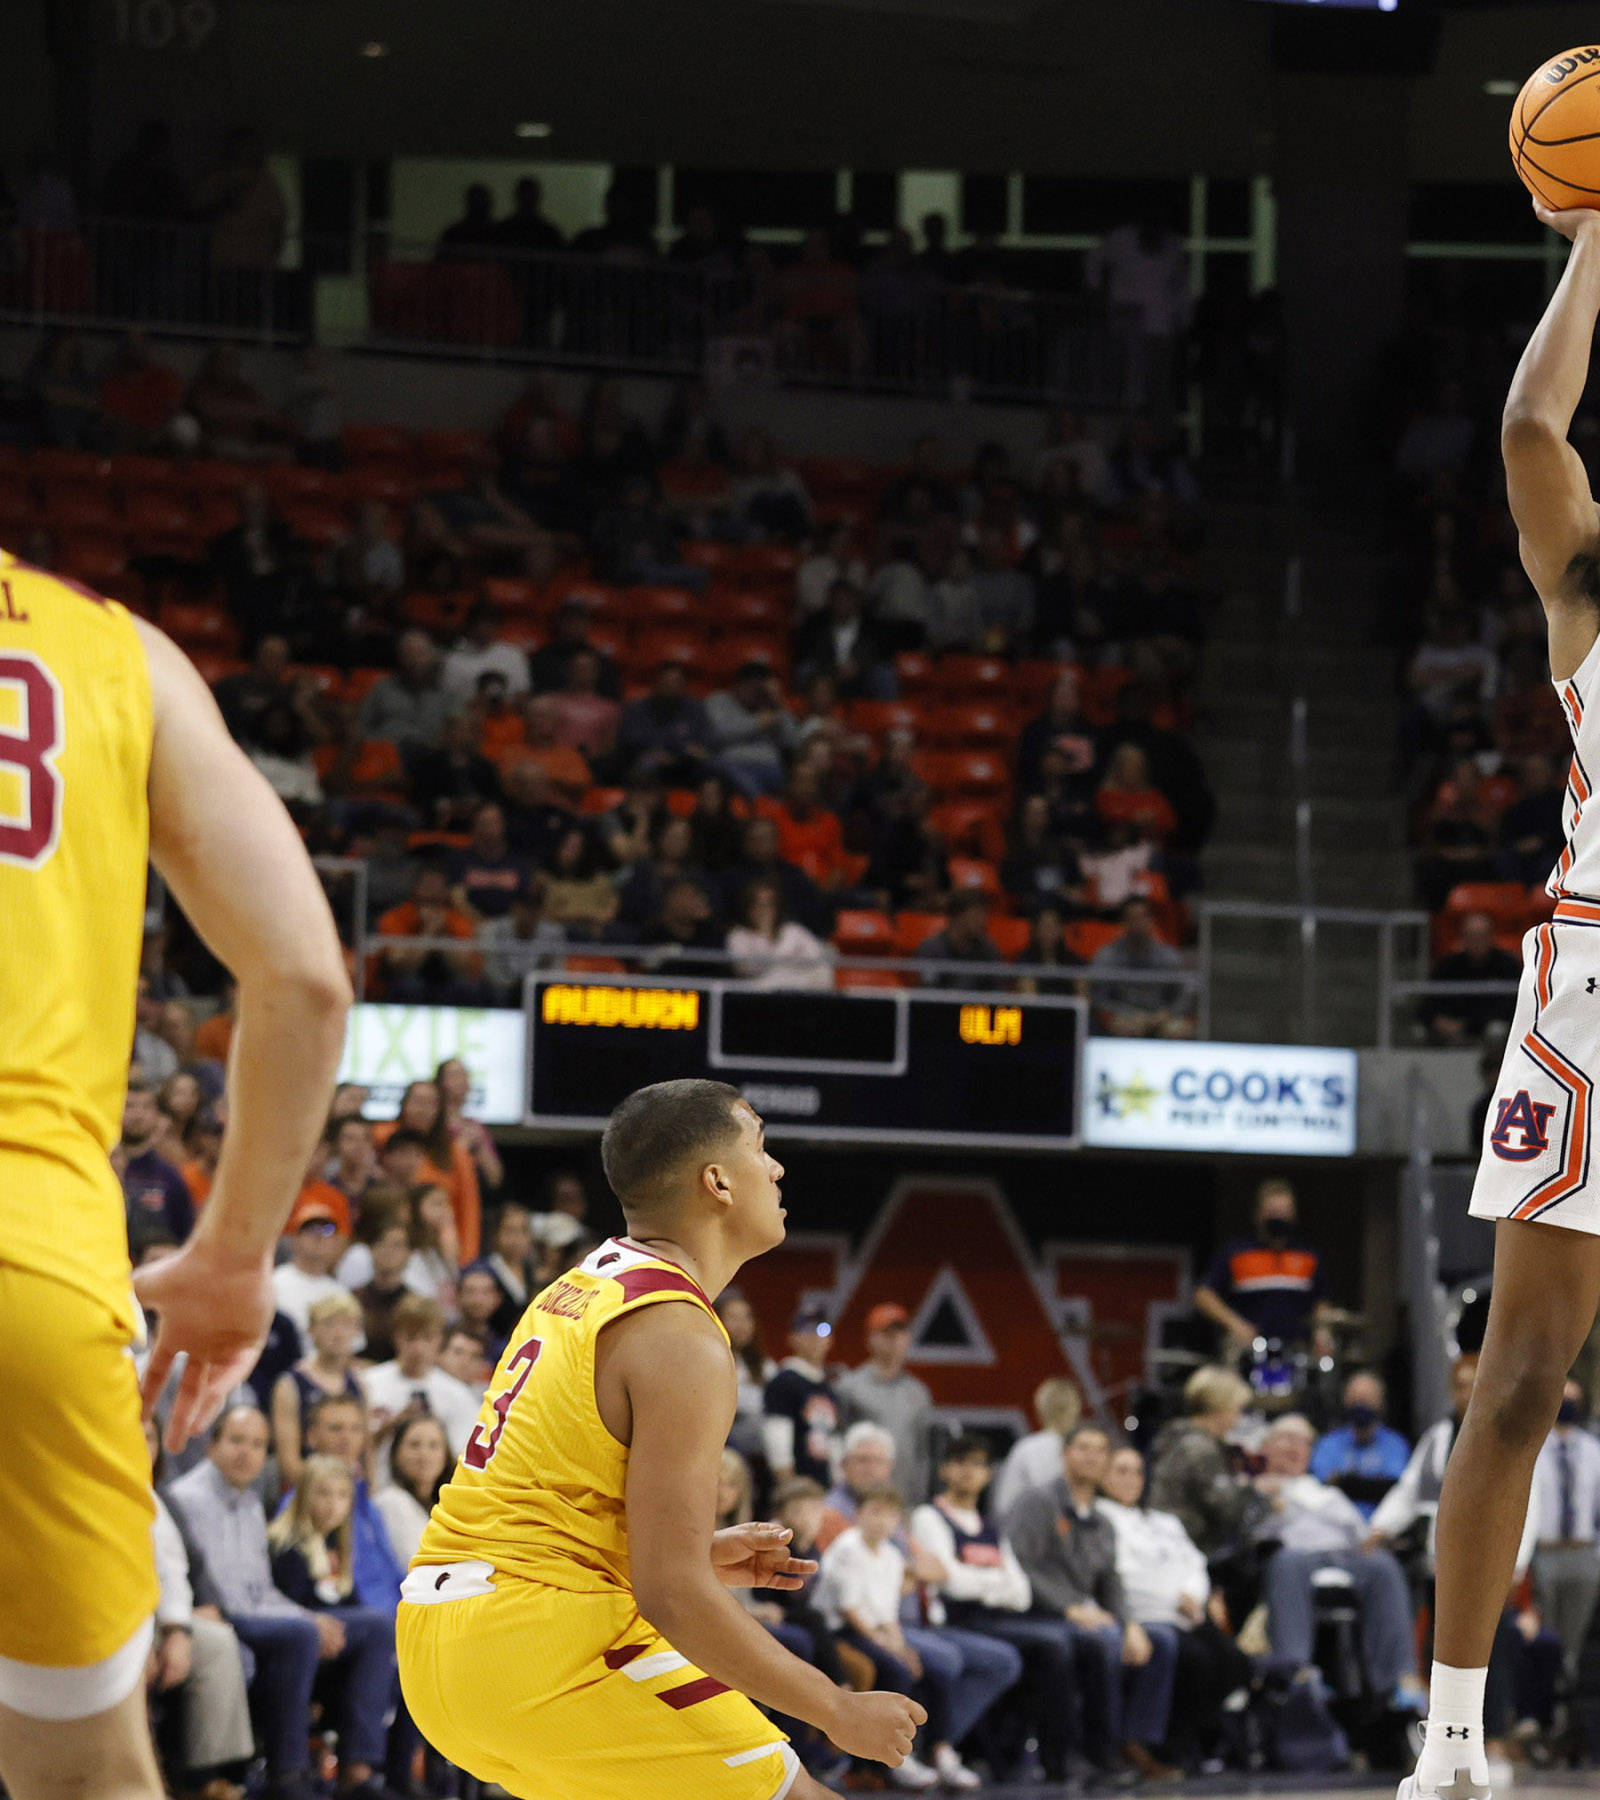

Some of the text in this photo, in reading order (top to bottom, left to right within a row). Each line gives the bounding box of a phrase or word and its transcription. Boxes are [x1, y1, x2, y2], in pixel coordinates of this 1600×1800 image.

[114, 0, 217, 49] 109
[543, 984, 699, 1030] AUBURN
[959, 1004, 1022, 1045] ULM
[1171, 1069, 1345, 1108] COOK'S
[462, 1336, 546, 1473] 3
